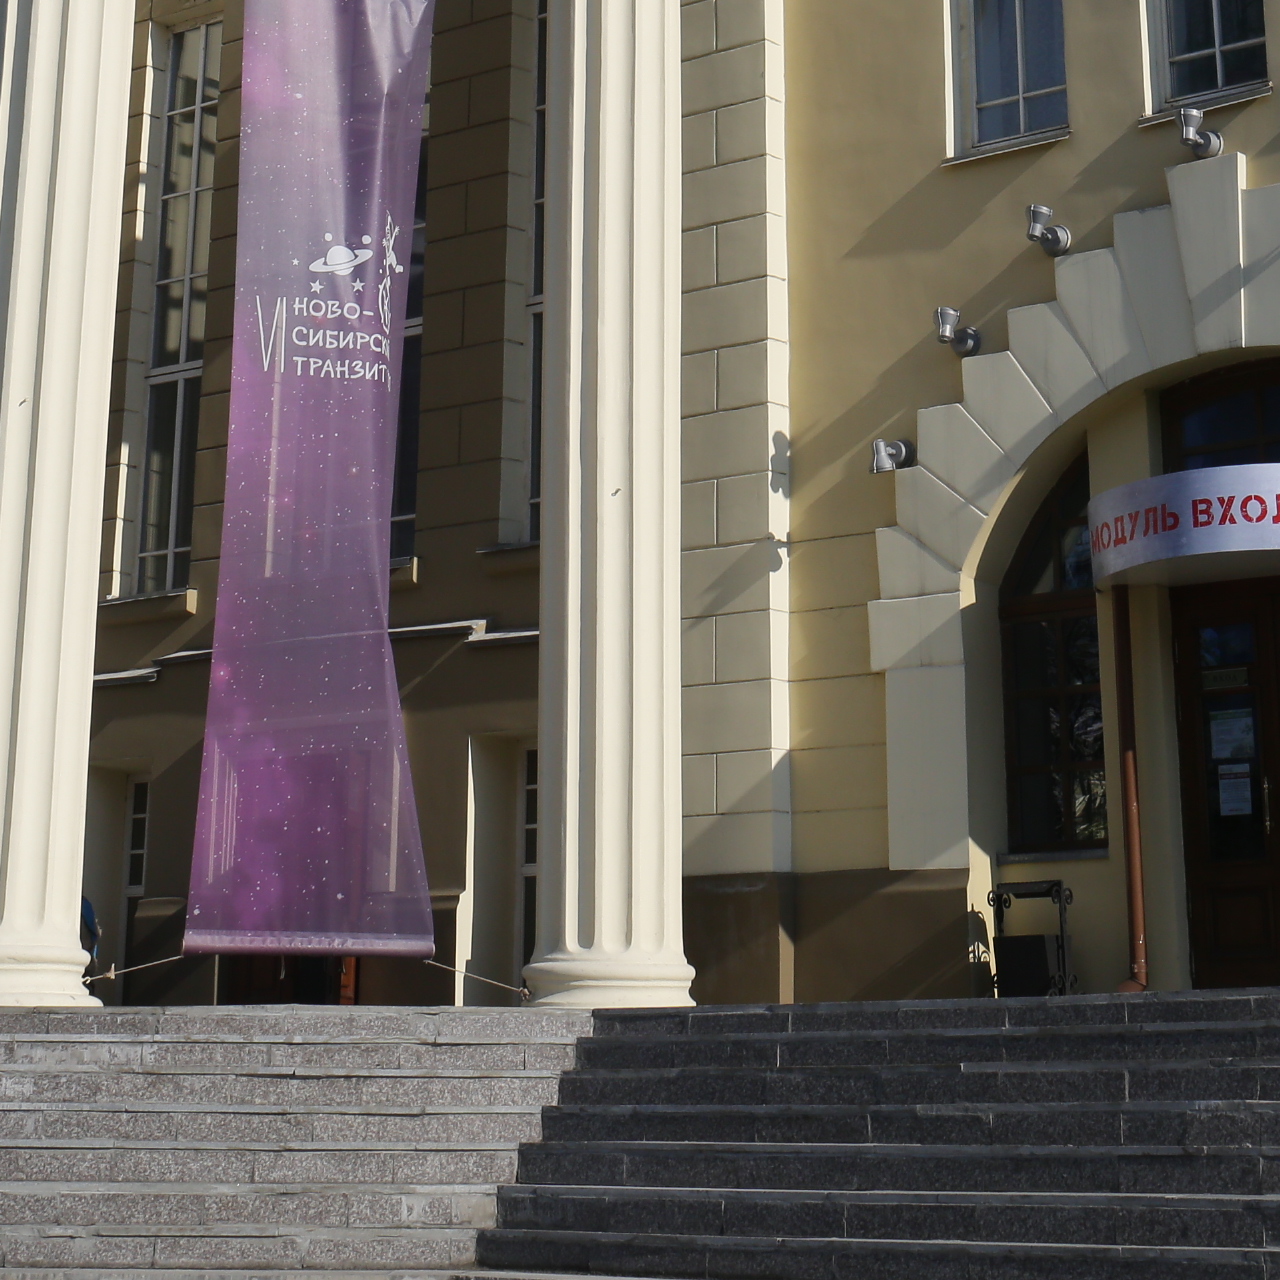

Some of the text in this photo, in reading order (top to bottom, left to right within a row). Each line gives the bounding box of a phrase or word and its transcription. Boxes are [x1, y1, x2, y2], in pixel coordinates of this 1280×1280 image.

[292, 296, 374, 319] НОВО-
[292, 356, 388, 382] ТРАНЗИТ
[1091, 503, 1180, 555] МОДУЛЬ
